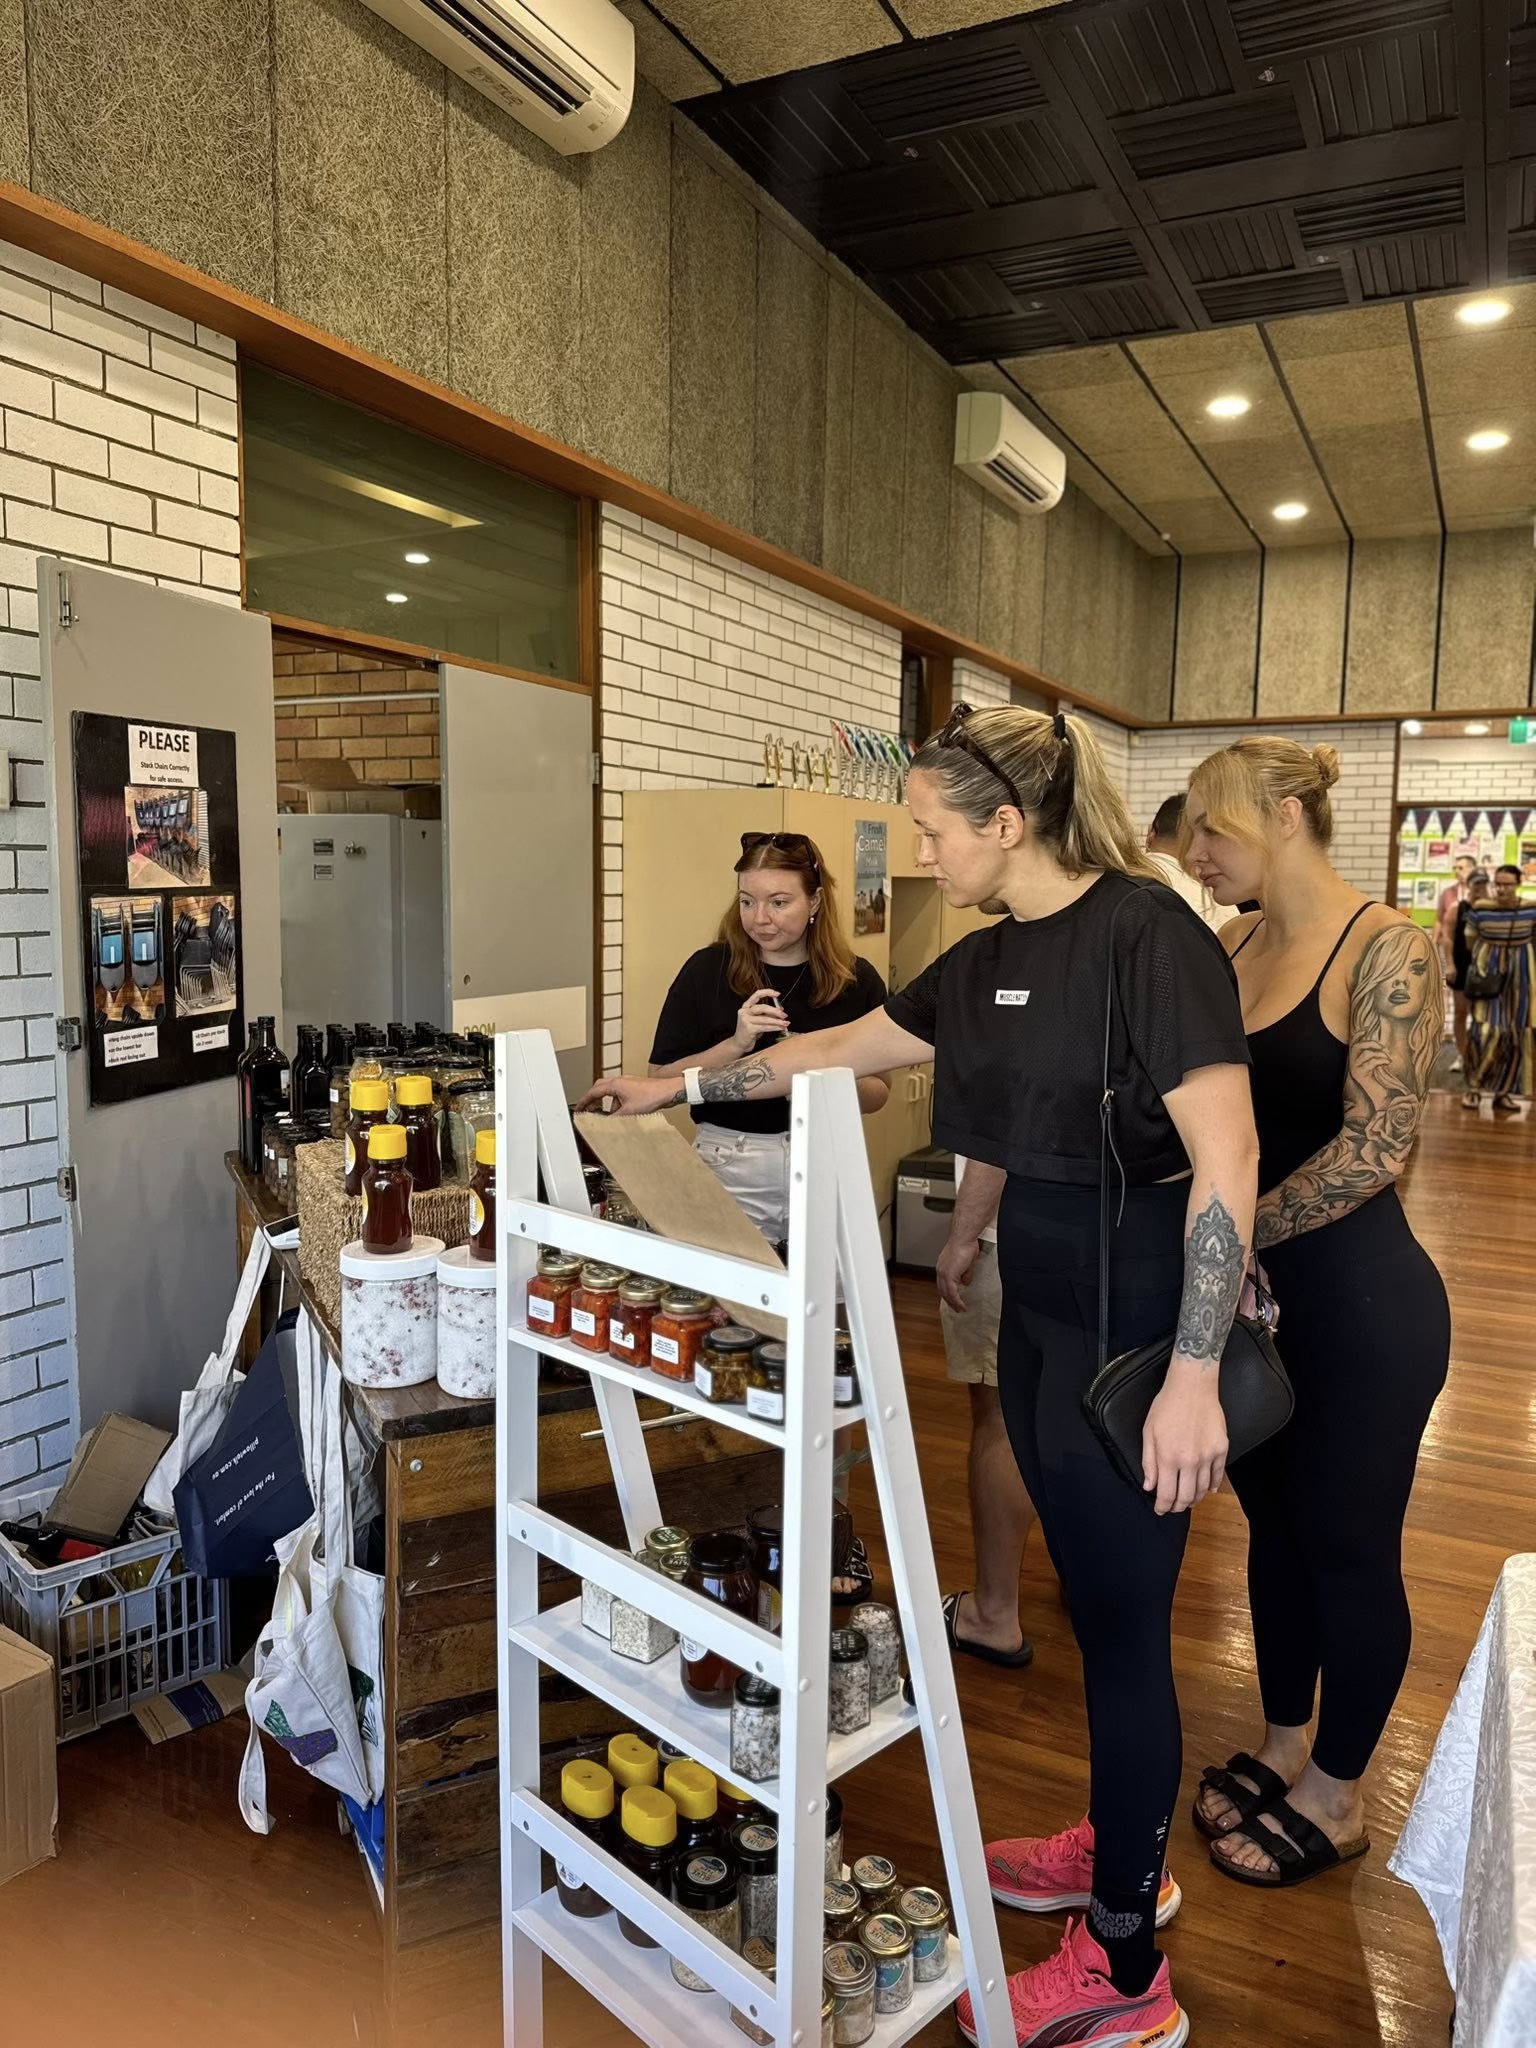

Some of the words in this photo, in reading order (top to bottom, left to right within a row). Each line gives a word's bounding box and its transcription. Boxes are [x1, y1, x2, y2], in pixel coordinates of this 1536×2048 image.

[139, 730, 190, 752] PLEASE
[169, 763, 190, 772] Correctly
[857, 835, 886, 852] Camel
[211, 1436, 259, 1480] pillowtalk.com.au
[265, 1472, 276, 1484] For
[255, 1481, 264, 1491] the
[243, 1488, 255, 1501] love
[237, 1500, 244, 1510] of
[214, 1506, 237, 1526] comfort.
[832, 1632, 841, 1650] OLIVE
[691, 1871, 711, 1881] OLIVE
[857, 1867, 876, 1881] OLIVE
[905, 1902, 926, 1915] OLIVE
[870, 1930, 889, 1945] OLIVE
[1140, 2030, 1165, 2046] NITRO
